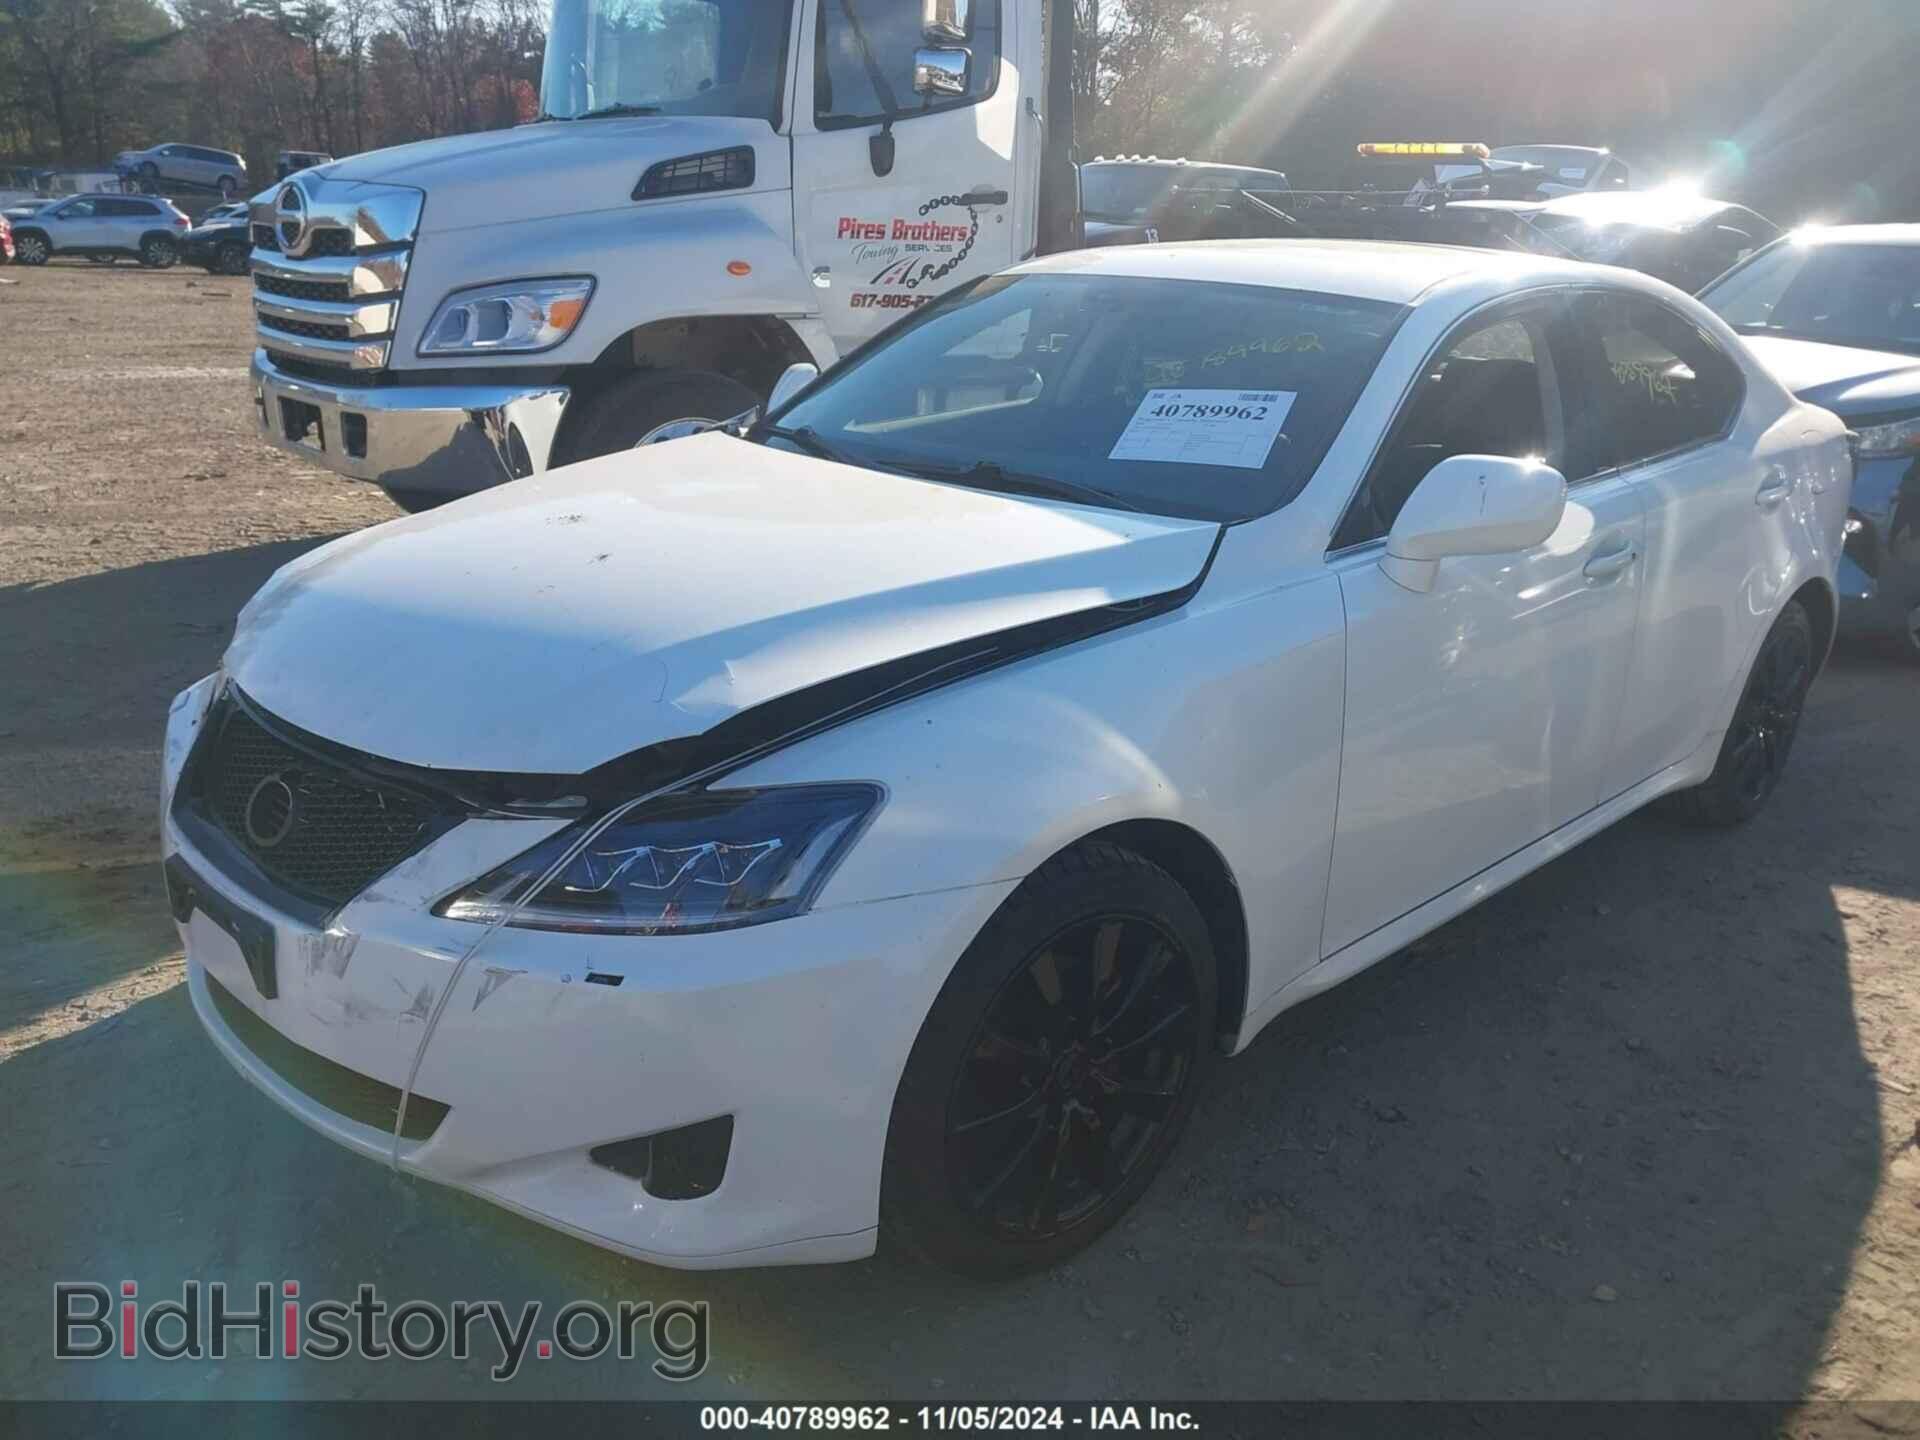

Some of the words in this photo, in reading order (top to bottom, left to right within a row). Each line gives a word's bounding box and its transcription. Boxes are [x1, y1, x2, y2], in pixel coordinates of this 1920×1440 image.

[837, 217, 886, 240] Pires
[891, 219, 968, 242] Brothers
[904, 243, 953, 253] SERCES
[1150, 403, 1269, 421] 40789962
